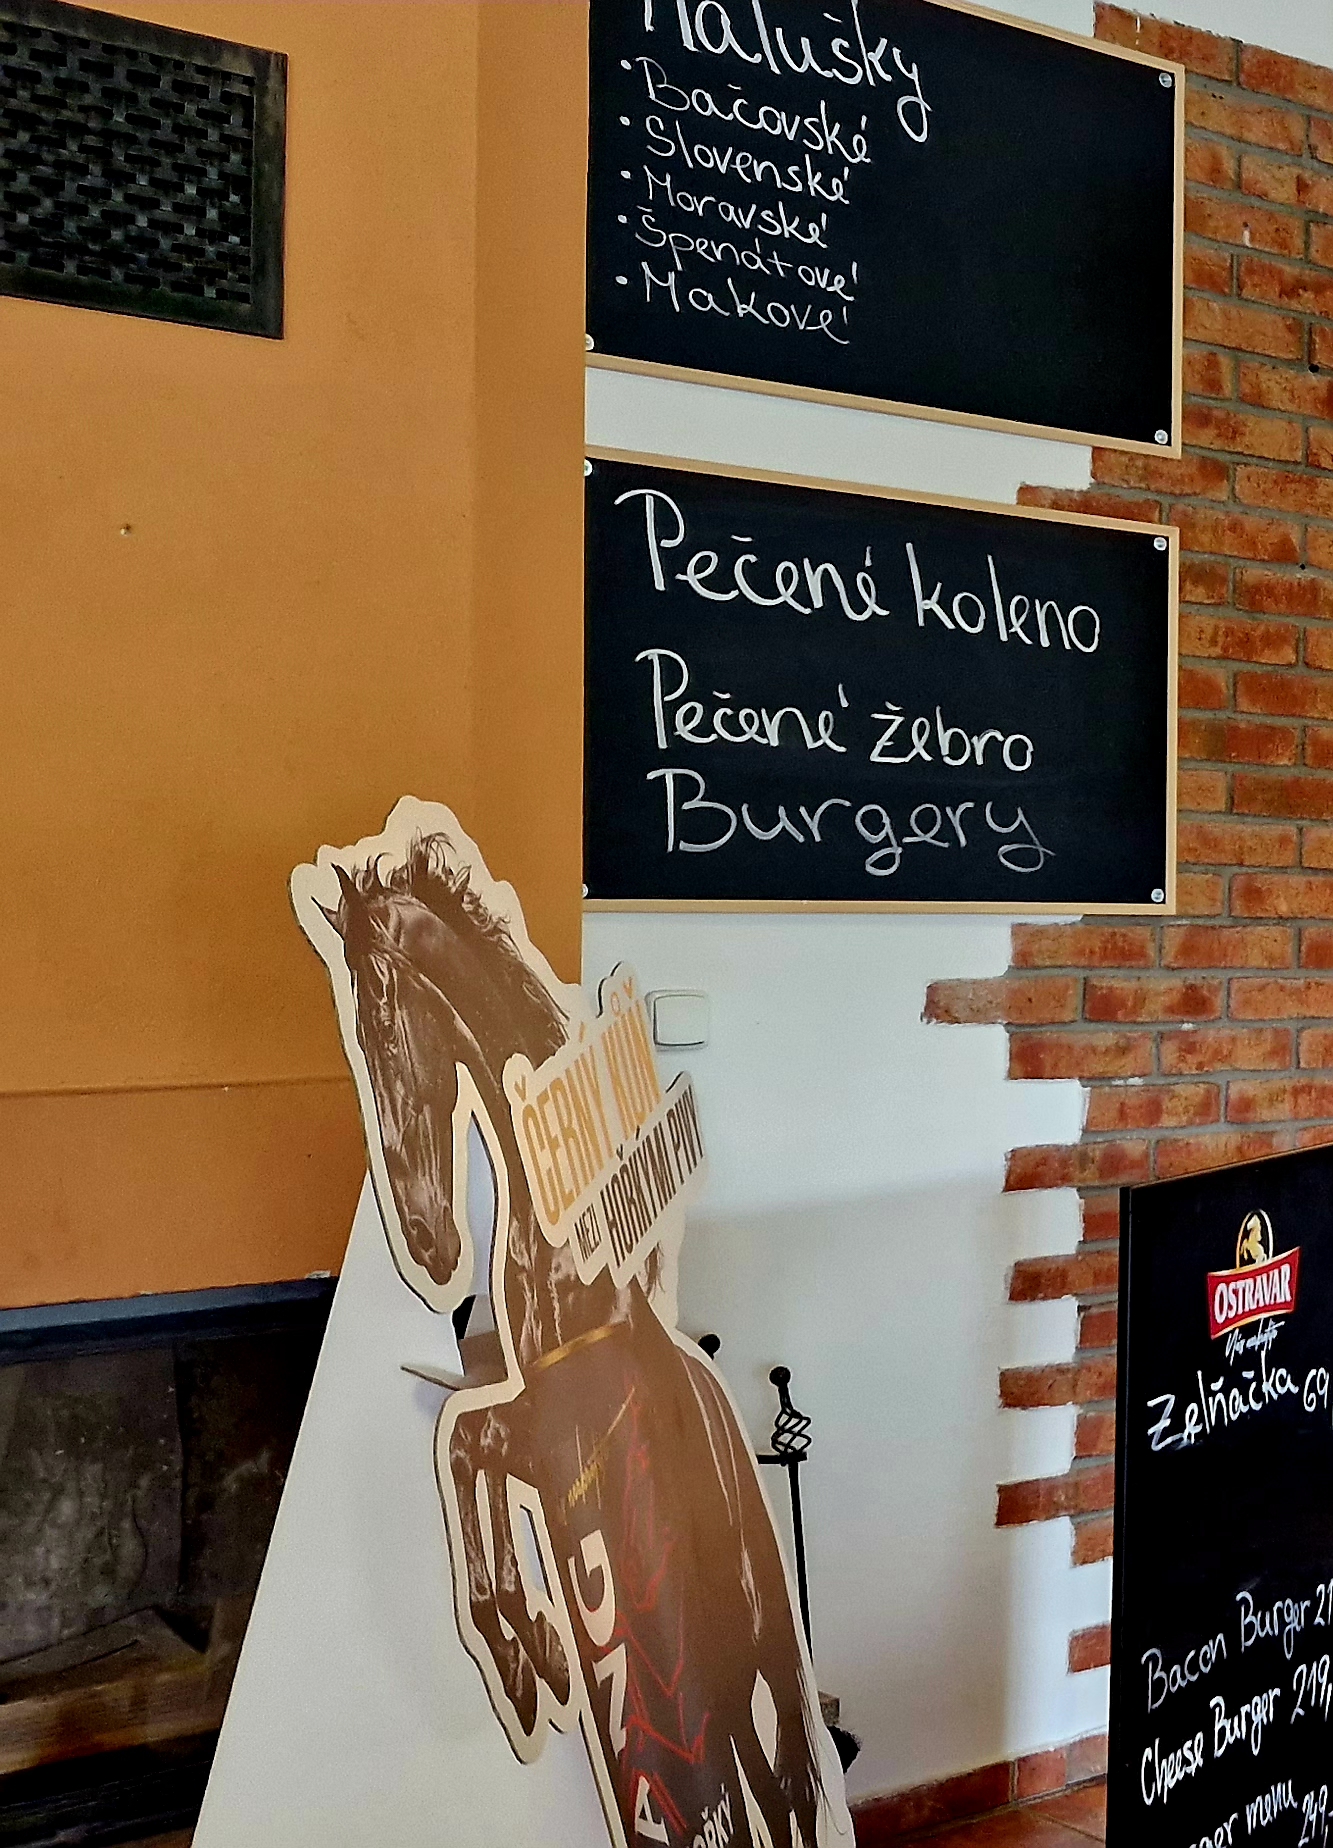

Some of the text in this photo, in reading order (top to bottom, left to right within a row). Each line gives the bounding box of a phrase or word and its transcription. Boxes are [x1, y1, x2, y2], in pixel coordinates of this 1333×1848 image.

[635, 57, 871, 163] Bačovské
[645, 116, 851, 205] Slovenské
[634, 205, 859, 301] Špenátové
[643, 164, 829, 249] Moravské
[641, 260, 851, 345] Makové
[614, 488, 1101, 653] Pečené koleno
[634, 648, 1035, 772] Pečené žebro
[646, 767, 1056, 877] Burgery
[514, 976, 662, 1226] ČERNÝ KŮŇ
[574, 1084, 704, 1269] MEZI HOŘKÝMI PIVY
[1214, 1262, 1294, 1325] OSTRAVAR
[1147, 1350, 1299, 1451] Zelňačka
[1141, 1633, 1228, 1713] Bacon
[1236, 1591, 1311, 1660] Burger
[1141, 1731, 1204, 1805] Cheese
[1210, 1687, 1281, 1757] Burger
[1245, 1779, 1298, 1834] menu
